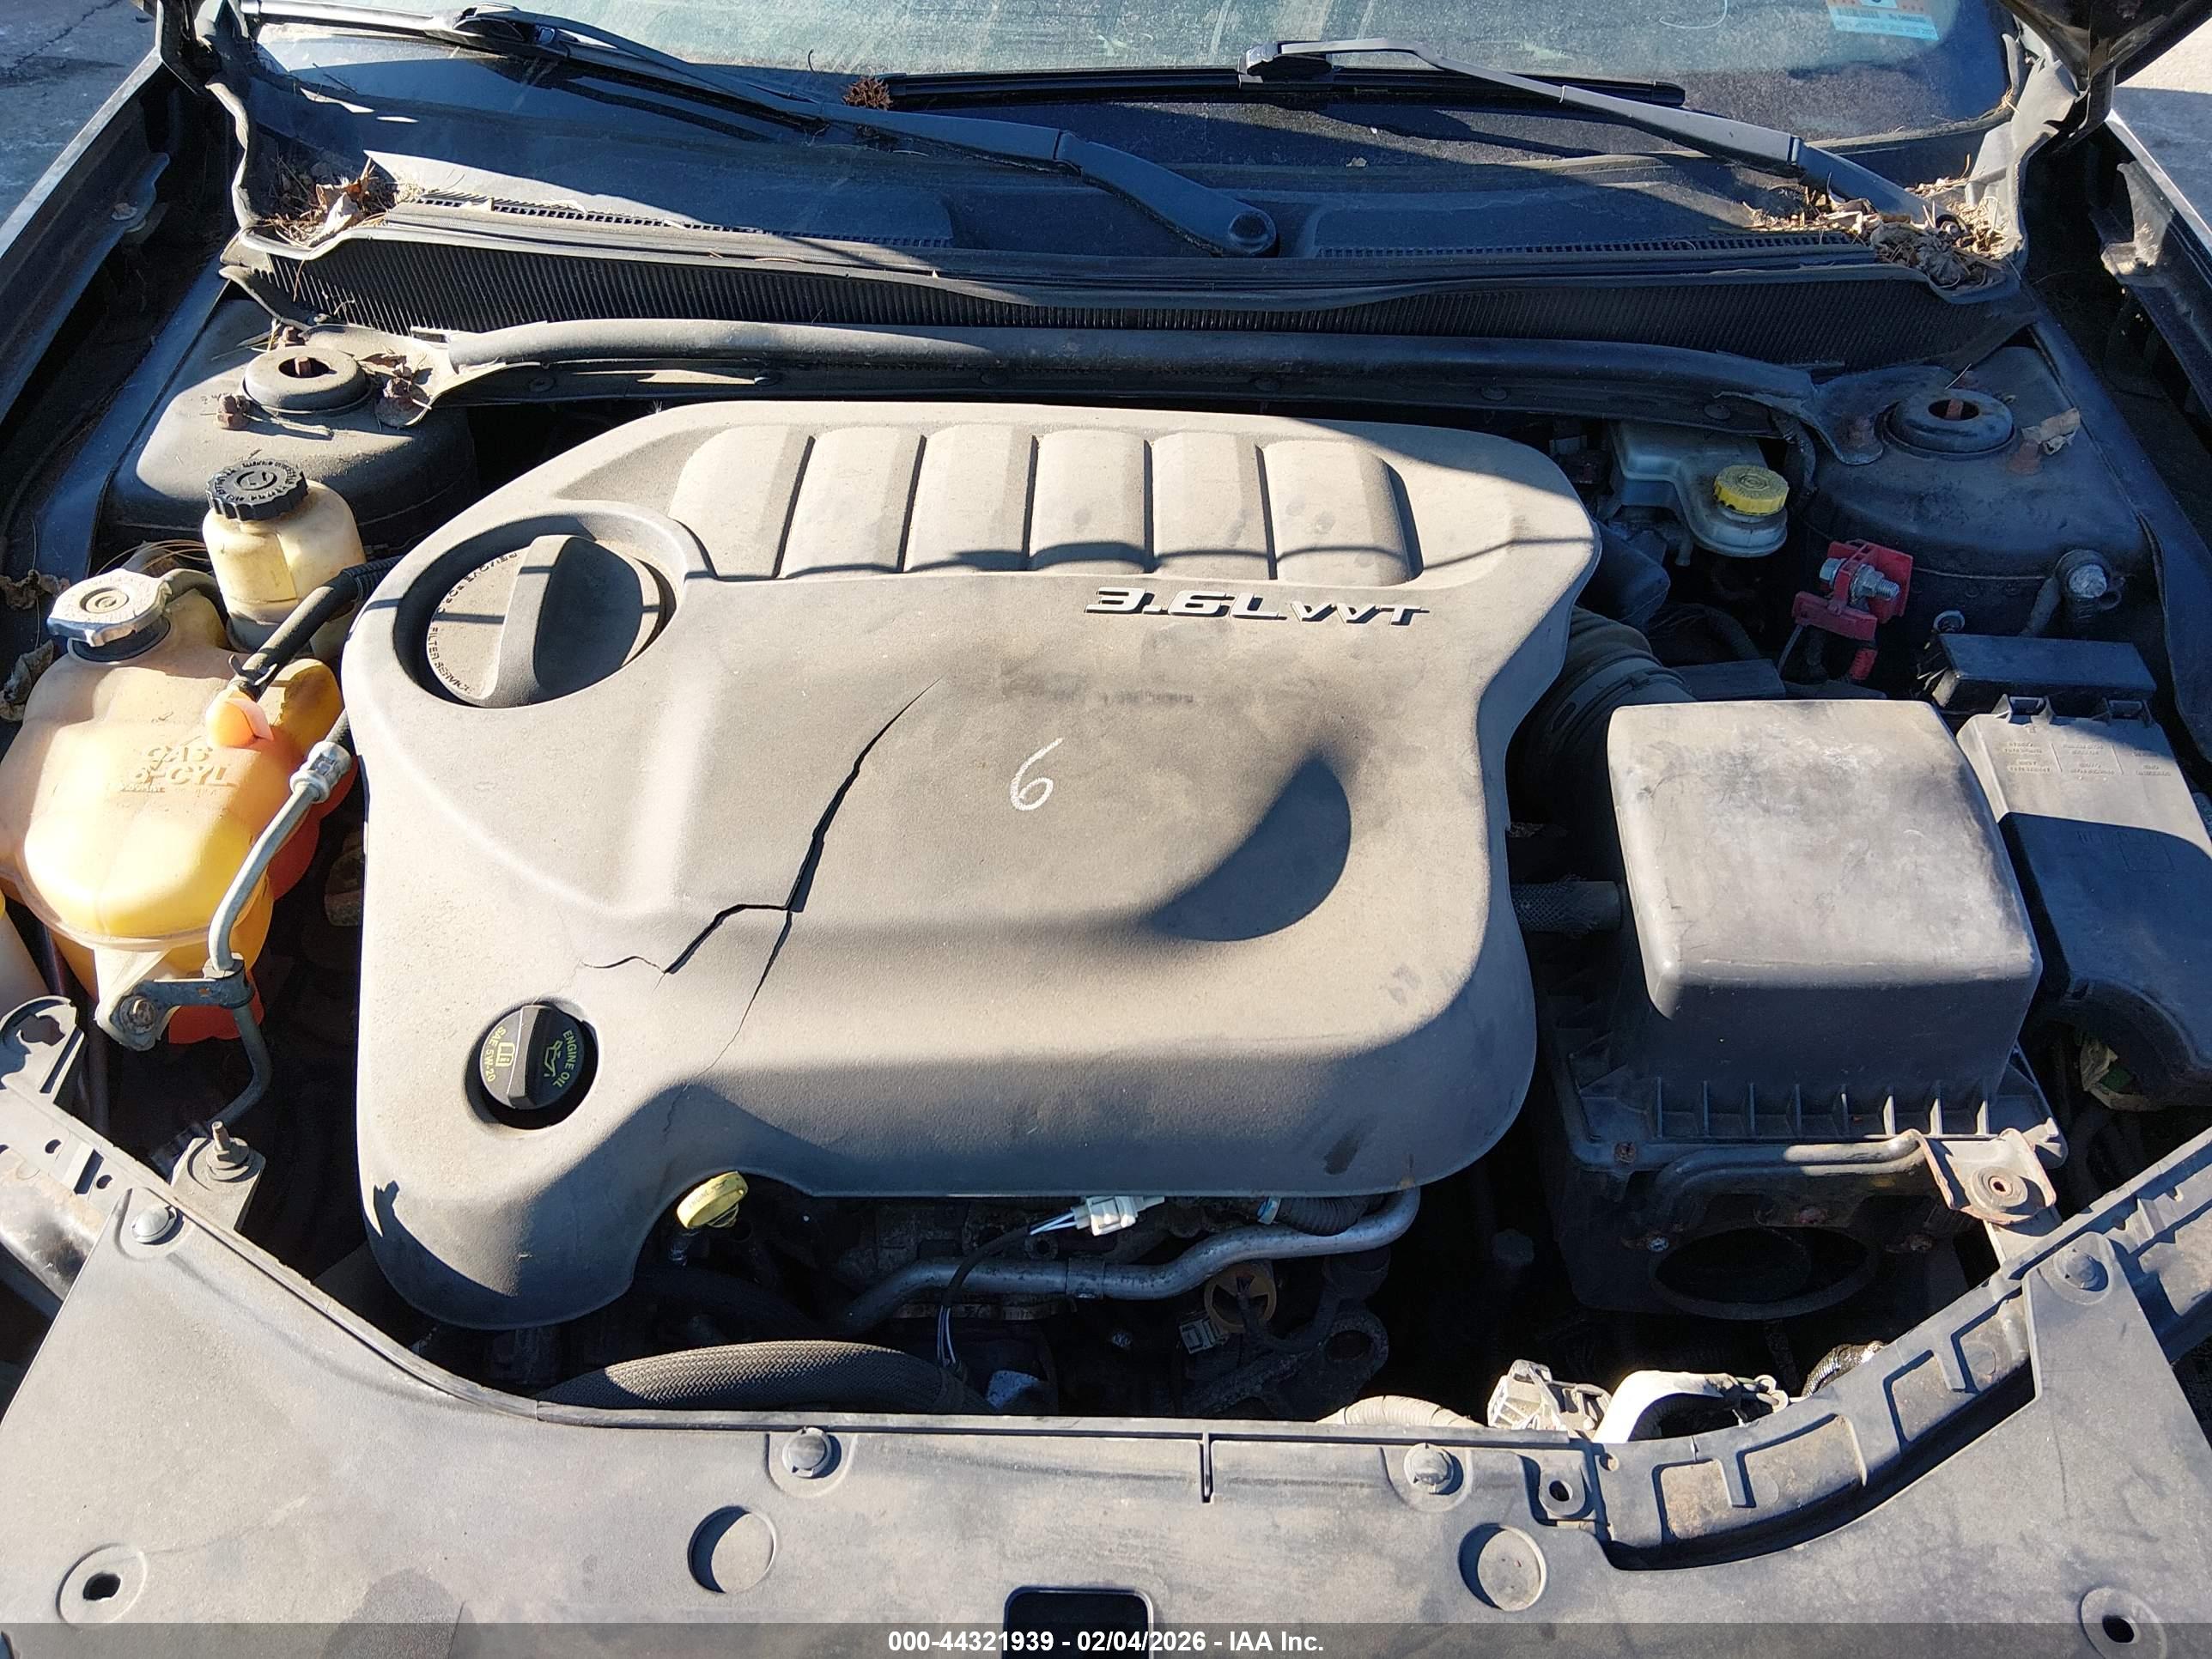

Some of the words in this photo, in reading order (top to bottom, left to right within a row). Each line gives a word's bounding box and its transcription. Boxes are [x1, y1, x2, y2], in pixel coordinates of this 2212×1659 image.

[1085, 586, 1281, 621] 3.6L
[1290, 601, 1425, 626] VVT
[428, 627, 440, 660] FILTER
[1010, 738, 1063, 811] 6
[488, 1026, 507, 1046] SAE
[562, 1030, 578, 1071] ENGINE
[483, 1049, 497, 1083] 5W-20
[552, 1071, 571, 1088] OIL
